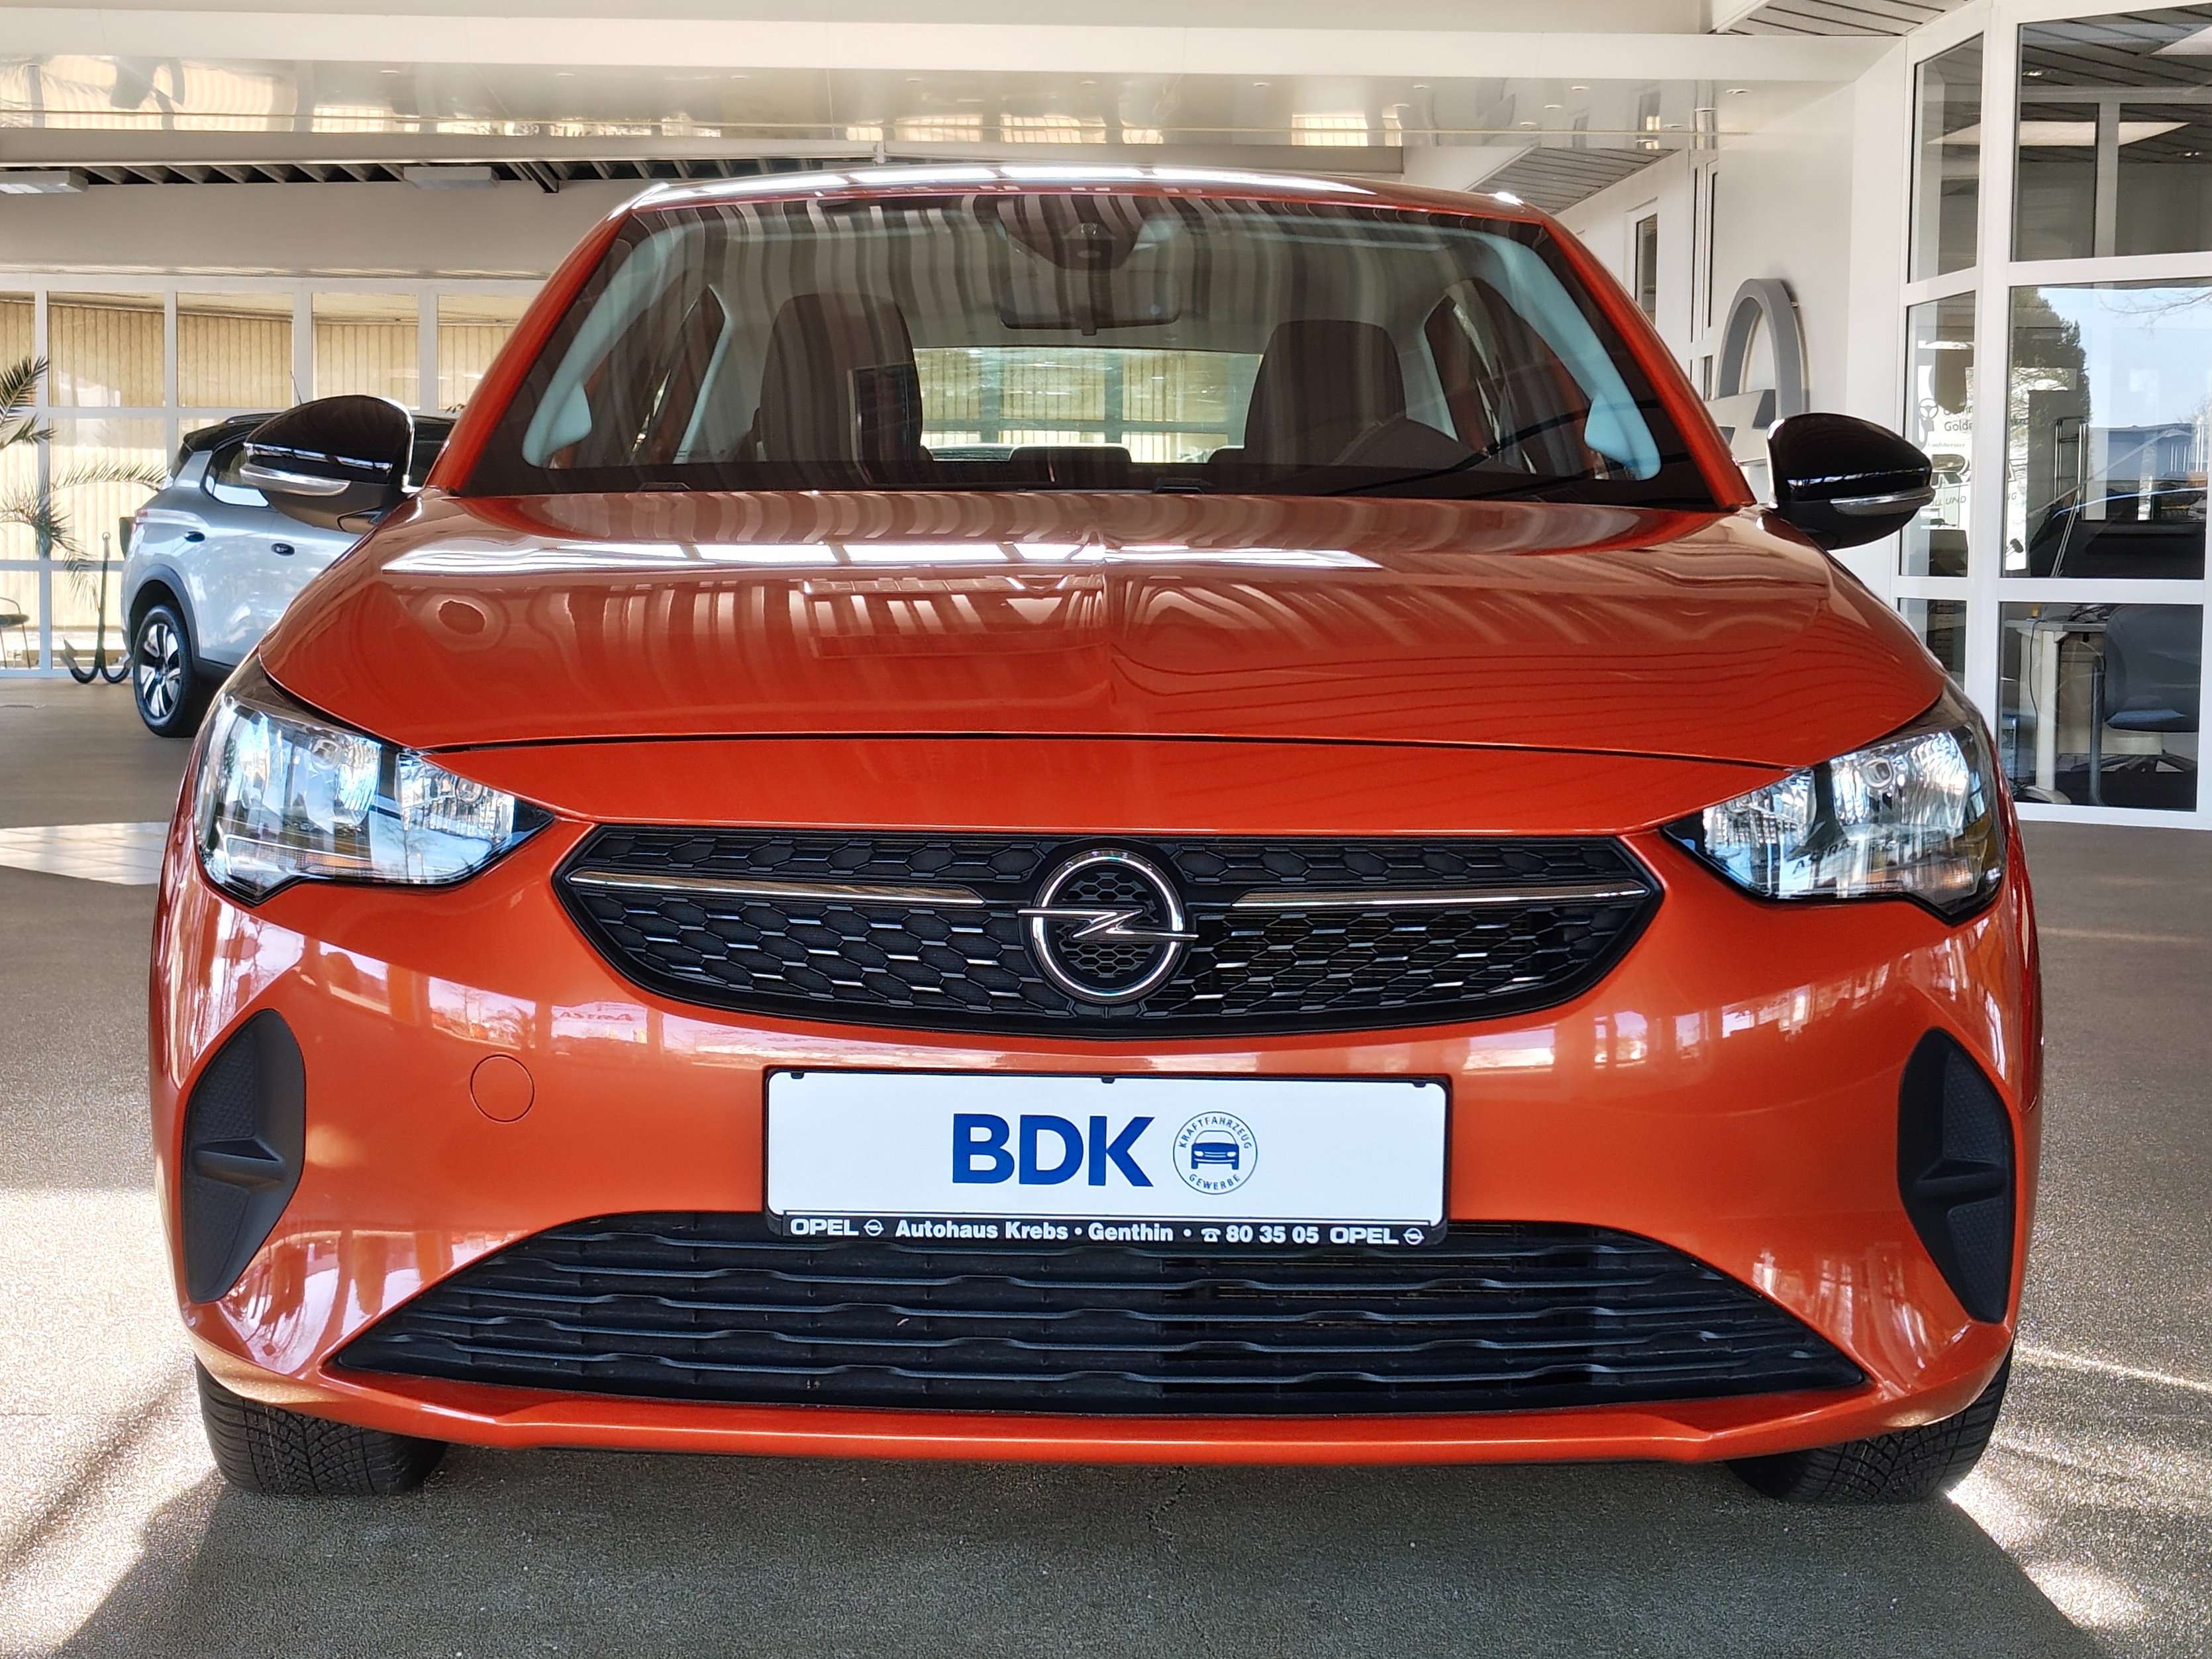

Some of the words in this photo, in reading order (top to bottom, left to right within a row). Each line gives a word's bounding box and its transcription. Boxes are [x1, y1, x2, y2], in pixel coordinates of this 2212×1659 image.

[1178, 1116, 1252, 1148] KRAFTFAHRZEUG
[952, 1113, 1155, 1187] BDK
[1189, 1174, 1240, 1190] GEWERBE
[790, 1218, 860, 1236] OPEL
[895, 1219, 998, 1238] Autohaus
[1005, 1221, 1068, 1240] Krebs
[1088, 1222, 1174, 1241] Genthin
[1226, 1225, 1253, 1242] 80
[1259, 1225, 1286, 1243] 35
[1292, 1226, 1319, 1244] 05
[1330, 1227, 1399, 1244] OPEL
